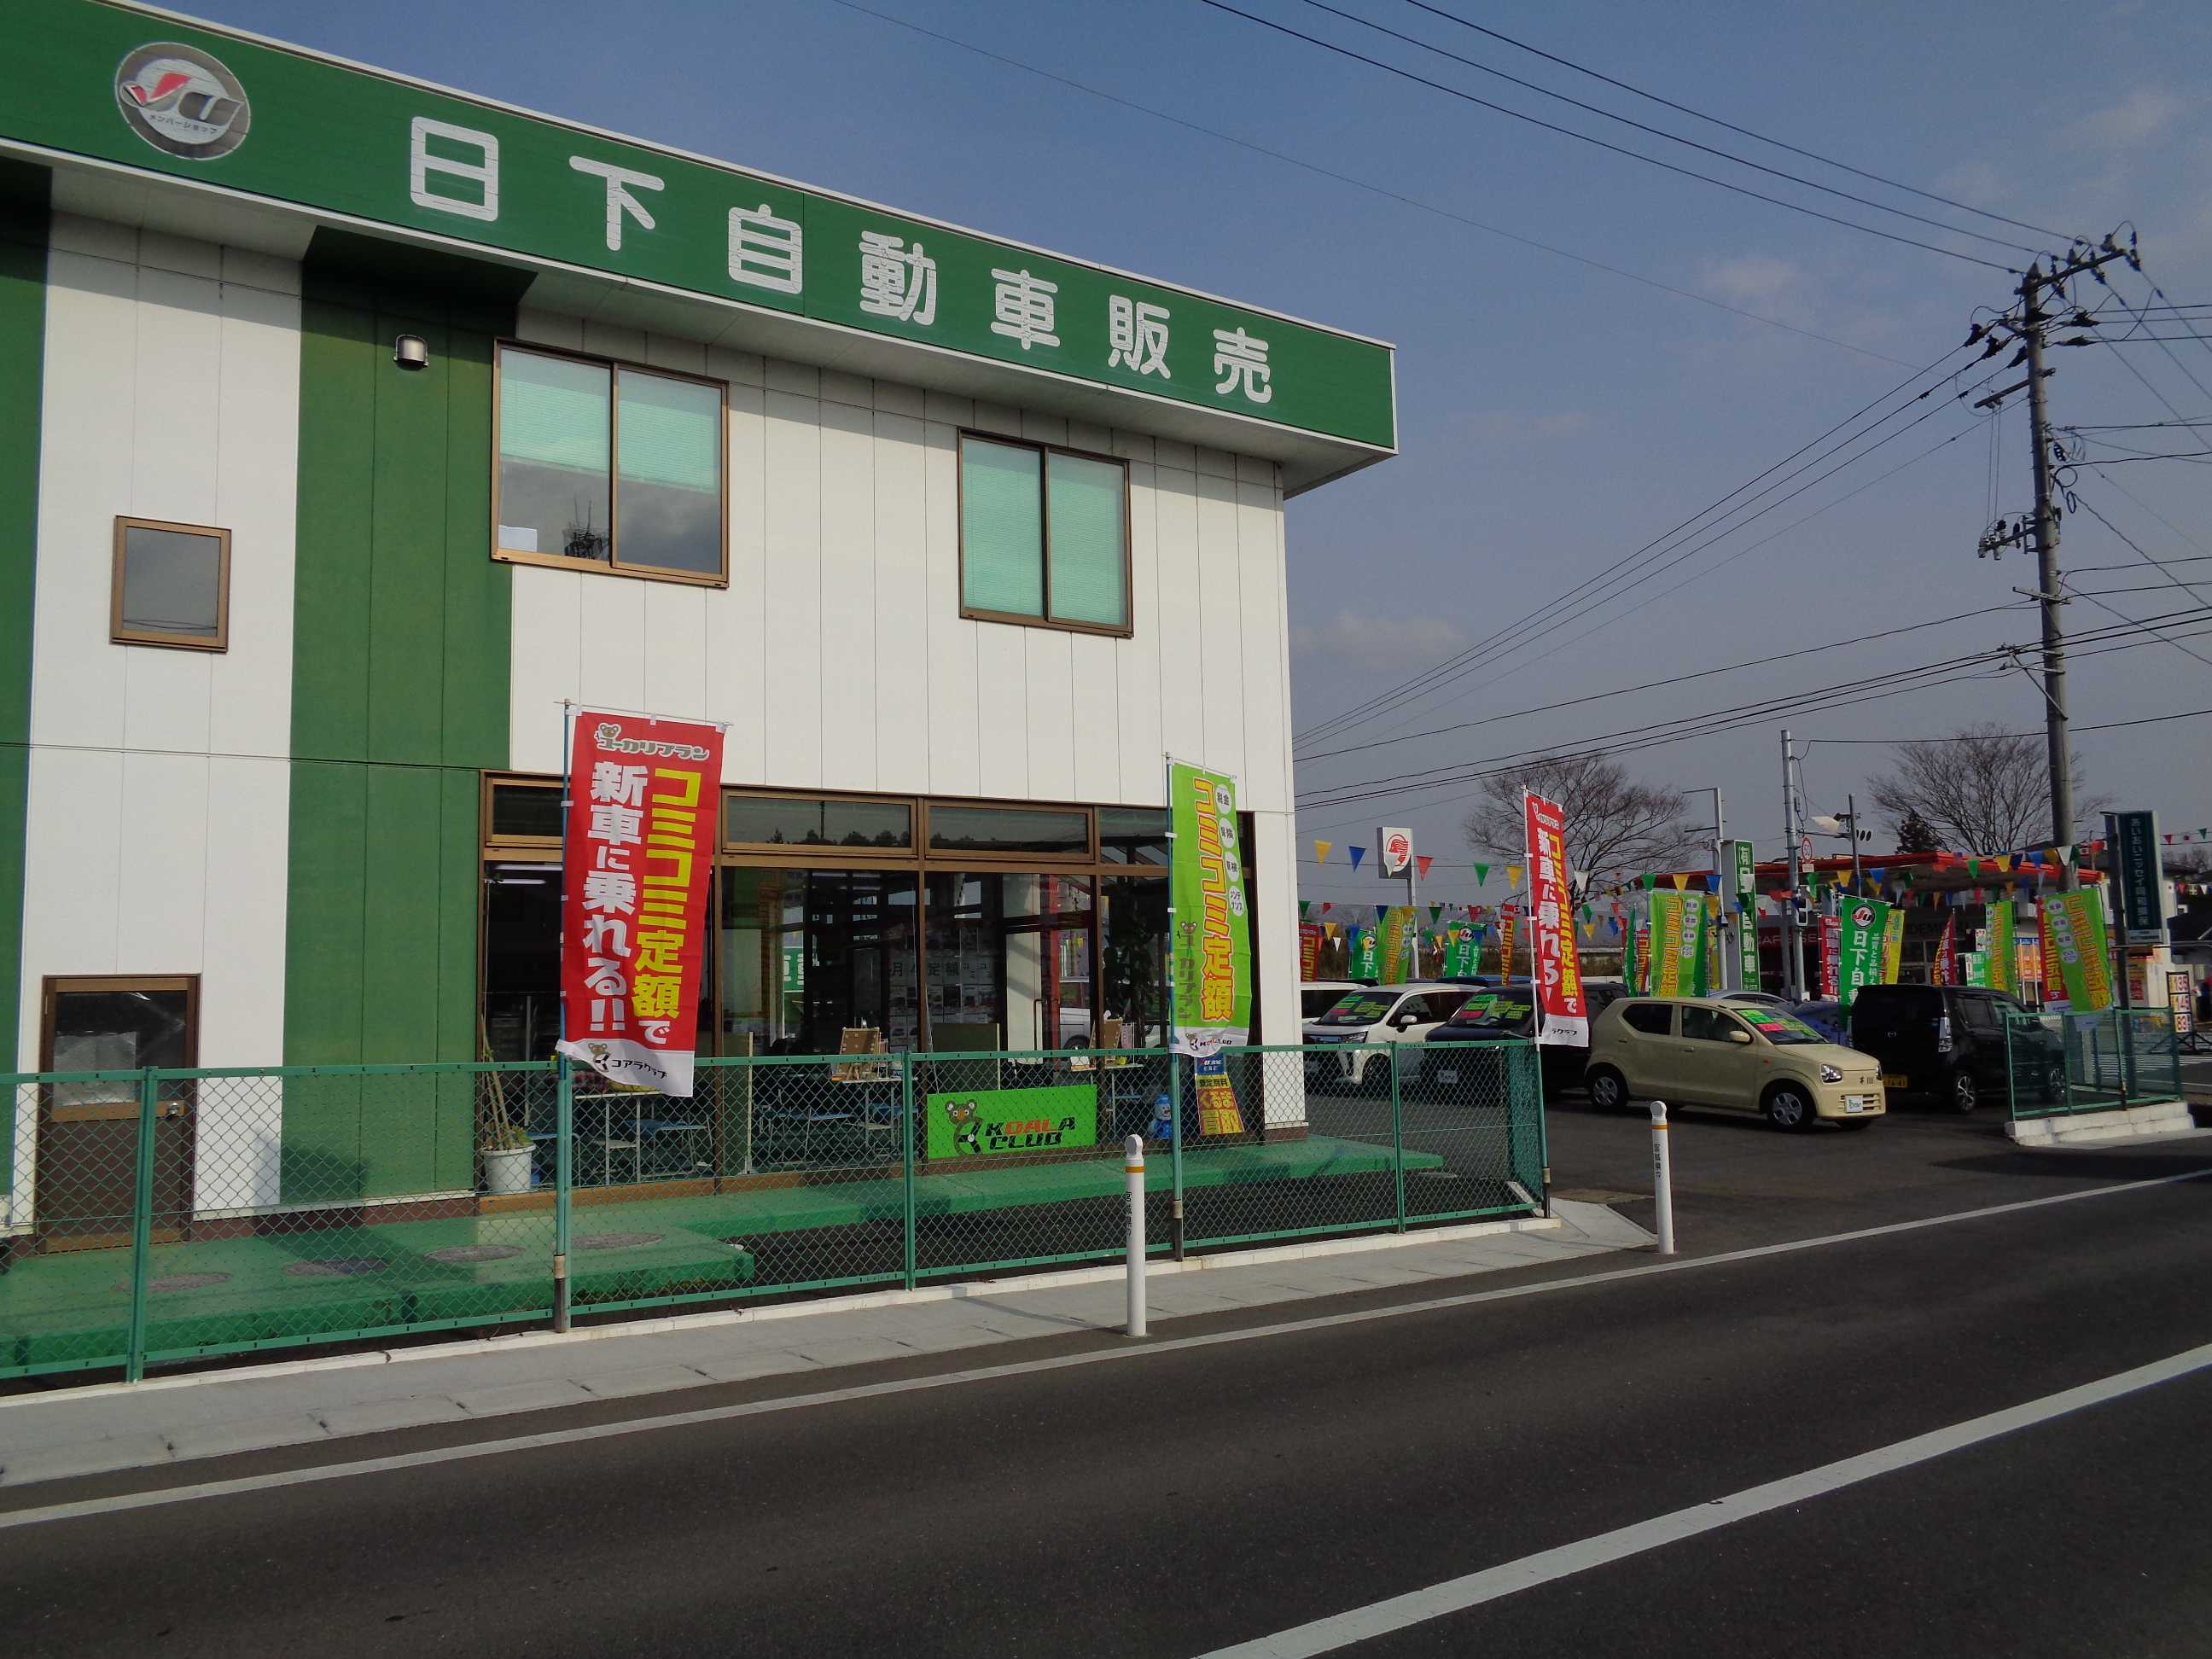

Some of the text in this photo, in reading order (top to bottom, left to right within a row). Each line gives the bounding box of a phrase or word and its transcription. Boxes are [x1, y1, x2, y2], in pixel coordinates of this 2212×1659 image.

[148, 113, 218, 135] メンバーショップ
[410, 115, 1272, 405] 日下自動車販売
[632, 767, 701, 1045] コミコミ定額で
[1193, 777, 1235, 1022] コミコミ定額
[985, 1116, 1075, 1137] KOALA
[1199, 1091, 1234, 1109] くるま
